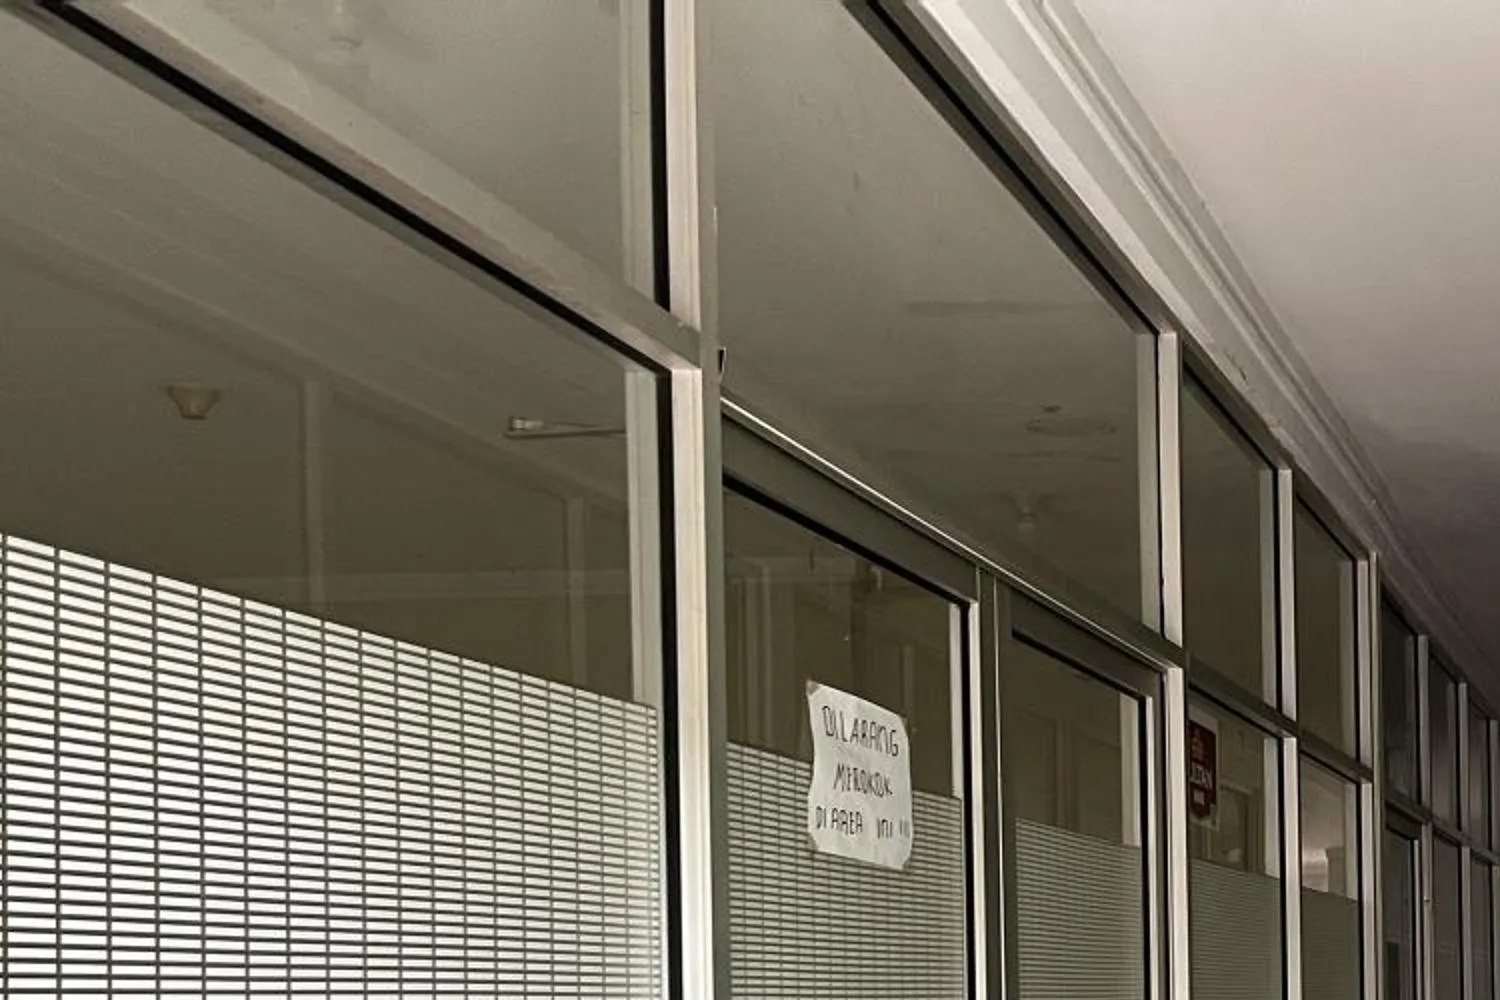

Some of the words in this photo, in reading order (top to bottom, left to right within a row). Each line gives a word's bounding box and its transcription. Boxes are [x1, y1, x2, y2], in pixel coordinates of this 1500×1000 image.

[821, 704, 899, 757] DILARANG
[816, 805, 827, 829] DI
[831, 807, 863, 835] AREA
